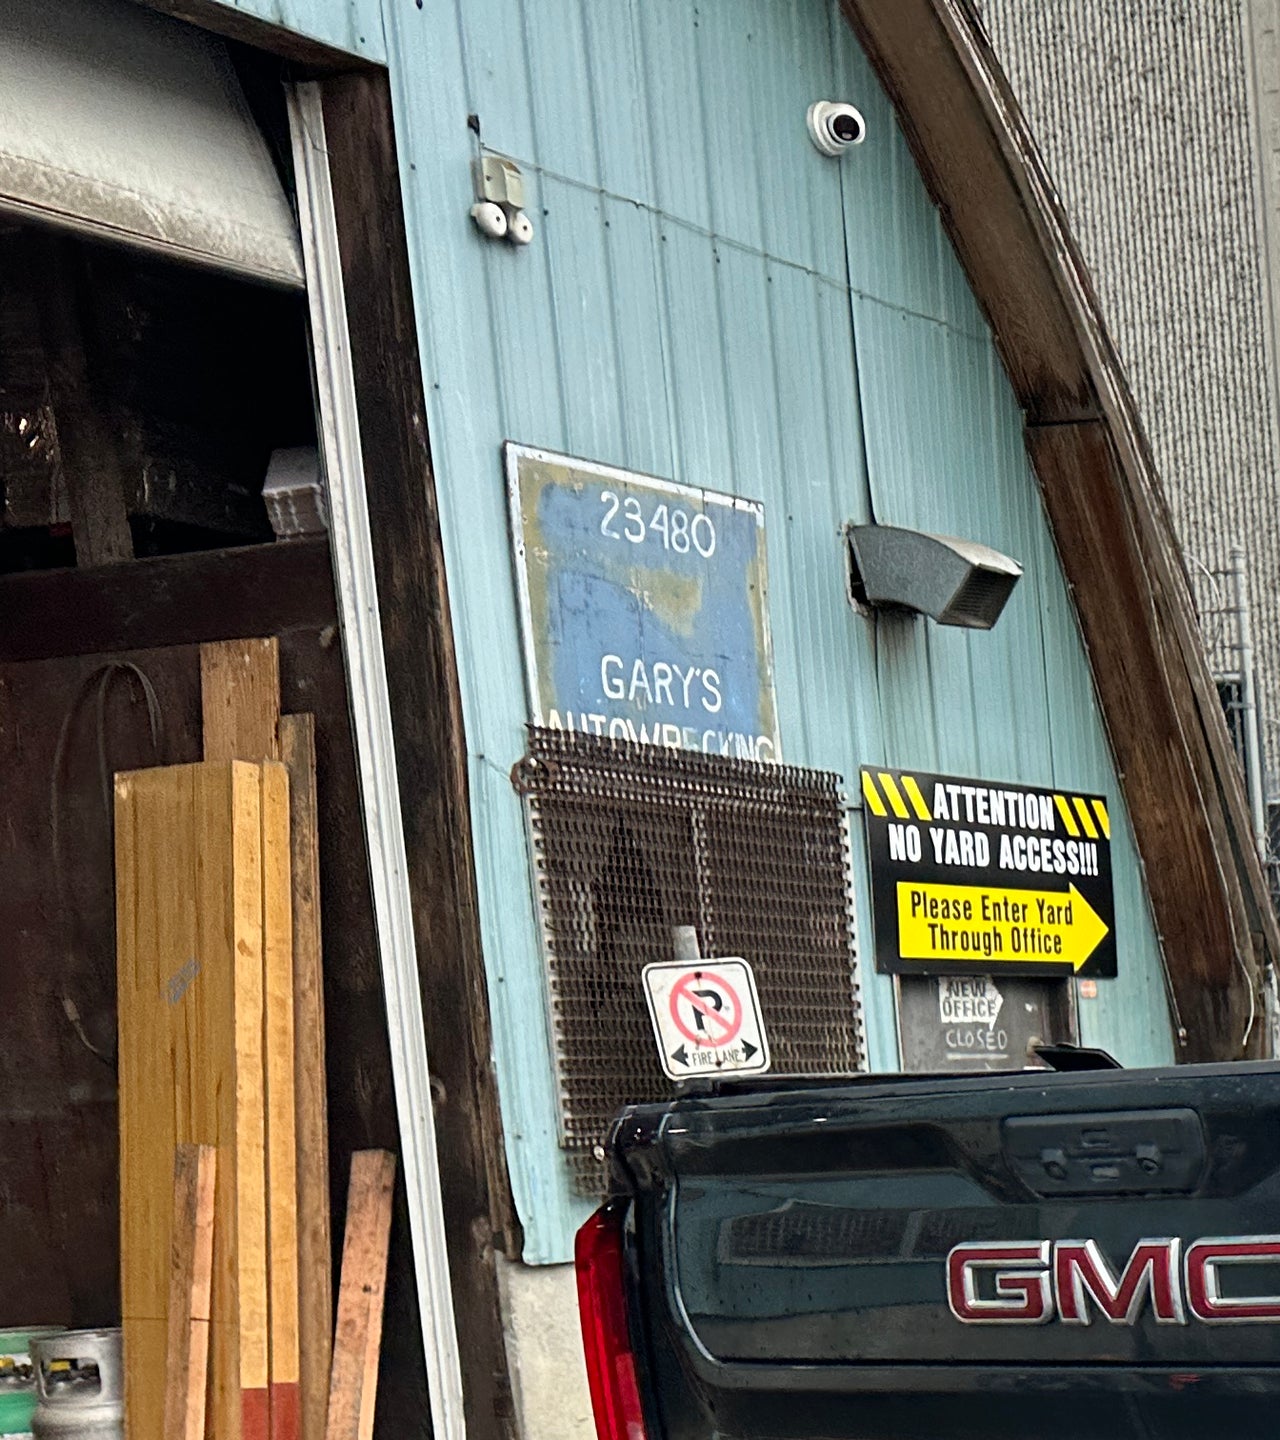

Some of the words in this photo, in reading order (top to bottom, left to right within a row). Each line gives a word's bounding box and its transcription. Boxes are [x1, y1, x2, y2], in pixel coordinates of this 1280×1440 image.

[600, 491, 716, 558] 23480
[601, 654, 722, 713] GARY'S
[933, 783, 1056, 831] ATTENTION
[888, 823, 922, 863] NO
[929, 827, 990, 868] YARD
[999, 833, 1099, 877] ACCESS!!!
[911, 890, 972, 920] Please
[981, 895, 1028, 924] Enter
[1036, 898, 1073, 926] Yard
[928, 923, 1002, 956] Through
[1011, 927, 1063, 955] Office
[950, 979, 987, 998] NEW
[942, 999, 998, 1018] OFFICE
[945, 1028, 1008, 1051] CLOSED
[692, 1051, 714, 1066] FIRE
[715, 1048, 742, 1065] LANE
